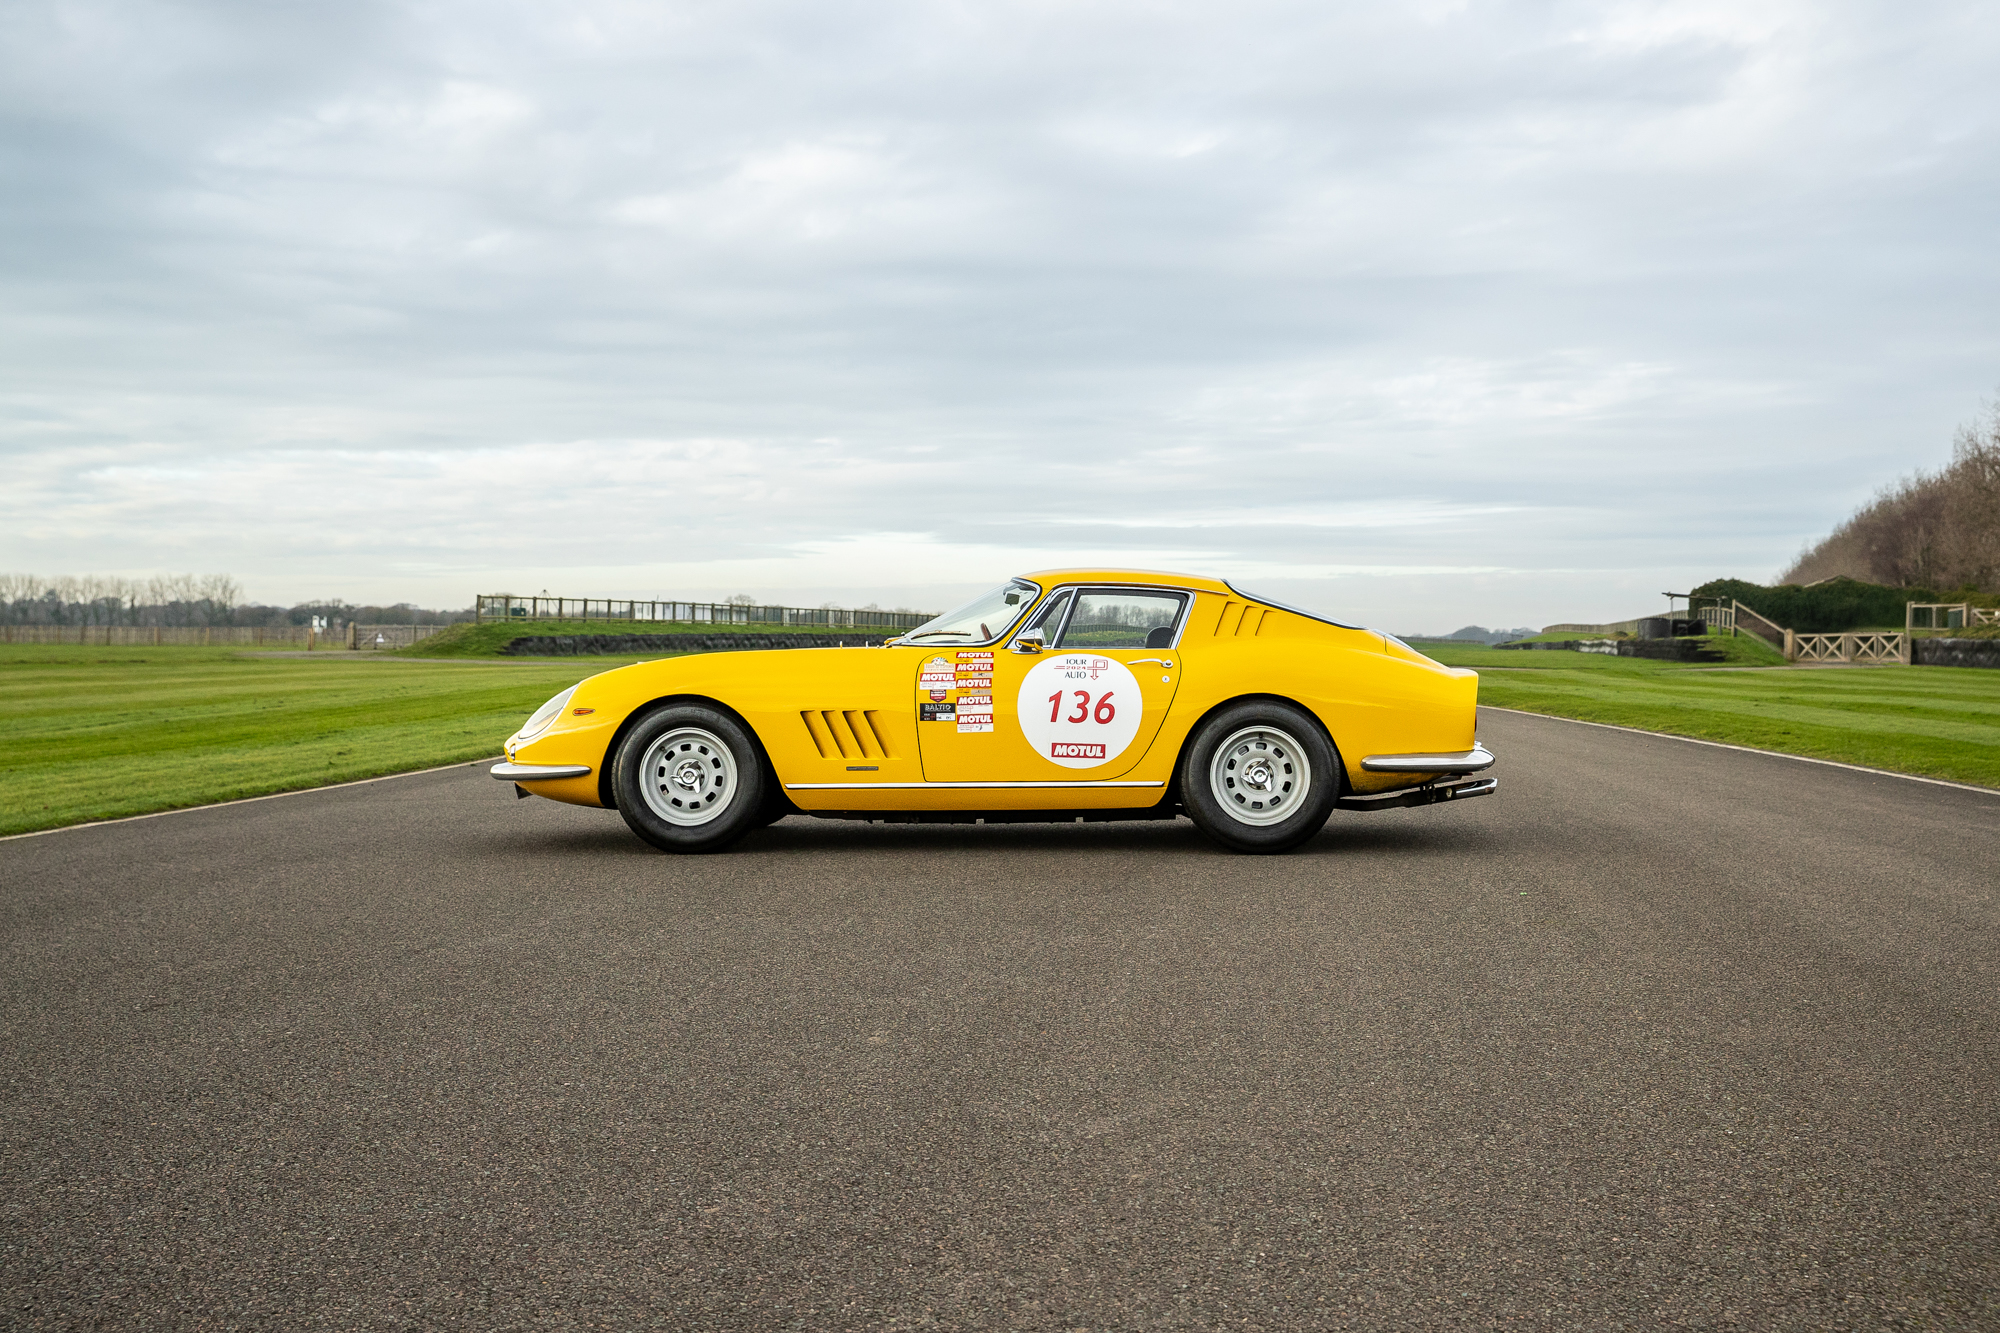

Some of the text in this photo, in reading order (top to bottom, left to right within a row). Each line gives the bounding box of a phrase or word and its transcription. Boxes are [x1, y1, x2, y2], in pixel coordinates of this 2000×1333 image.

[921, 673, 955, 681] MOTUL
[1065, 671, 1087, 679] AUTO
[956, 679, 991, 687] MOTUL
[958, 696, 991, 704] MOTUL
[1048, 690, 1116, 724] 136
[958, 715, 992, 723] MOTUL
[1053, 744, 1104, 757] MOTUL
